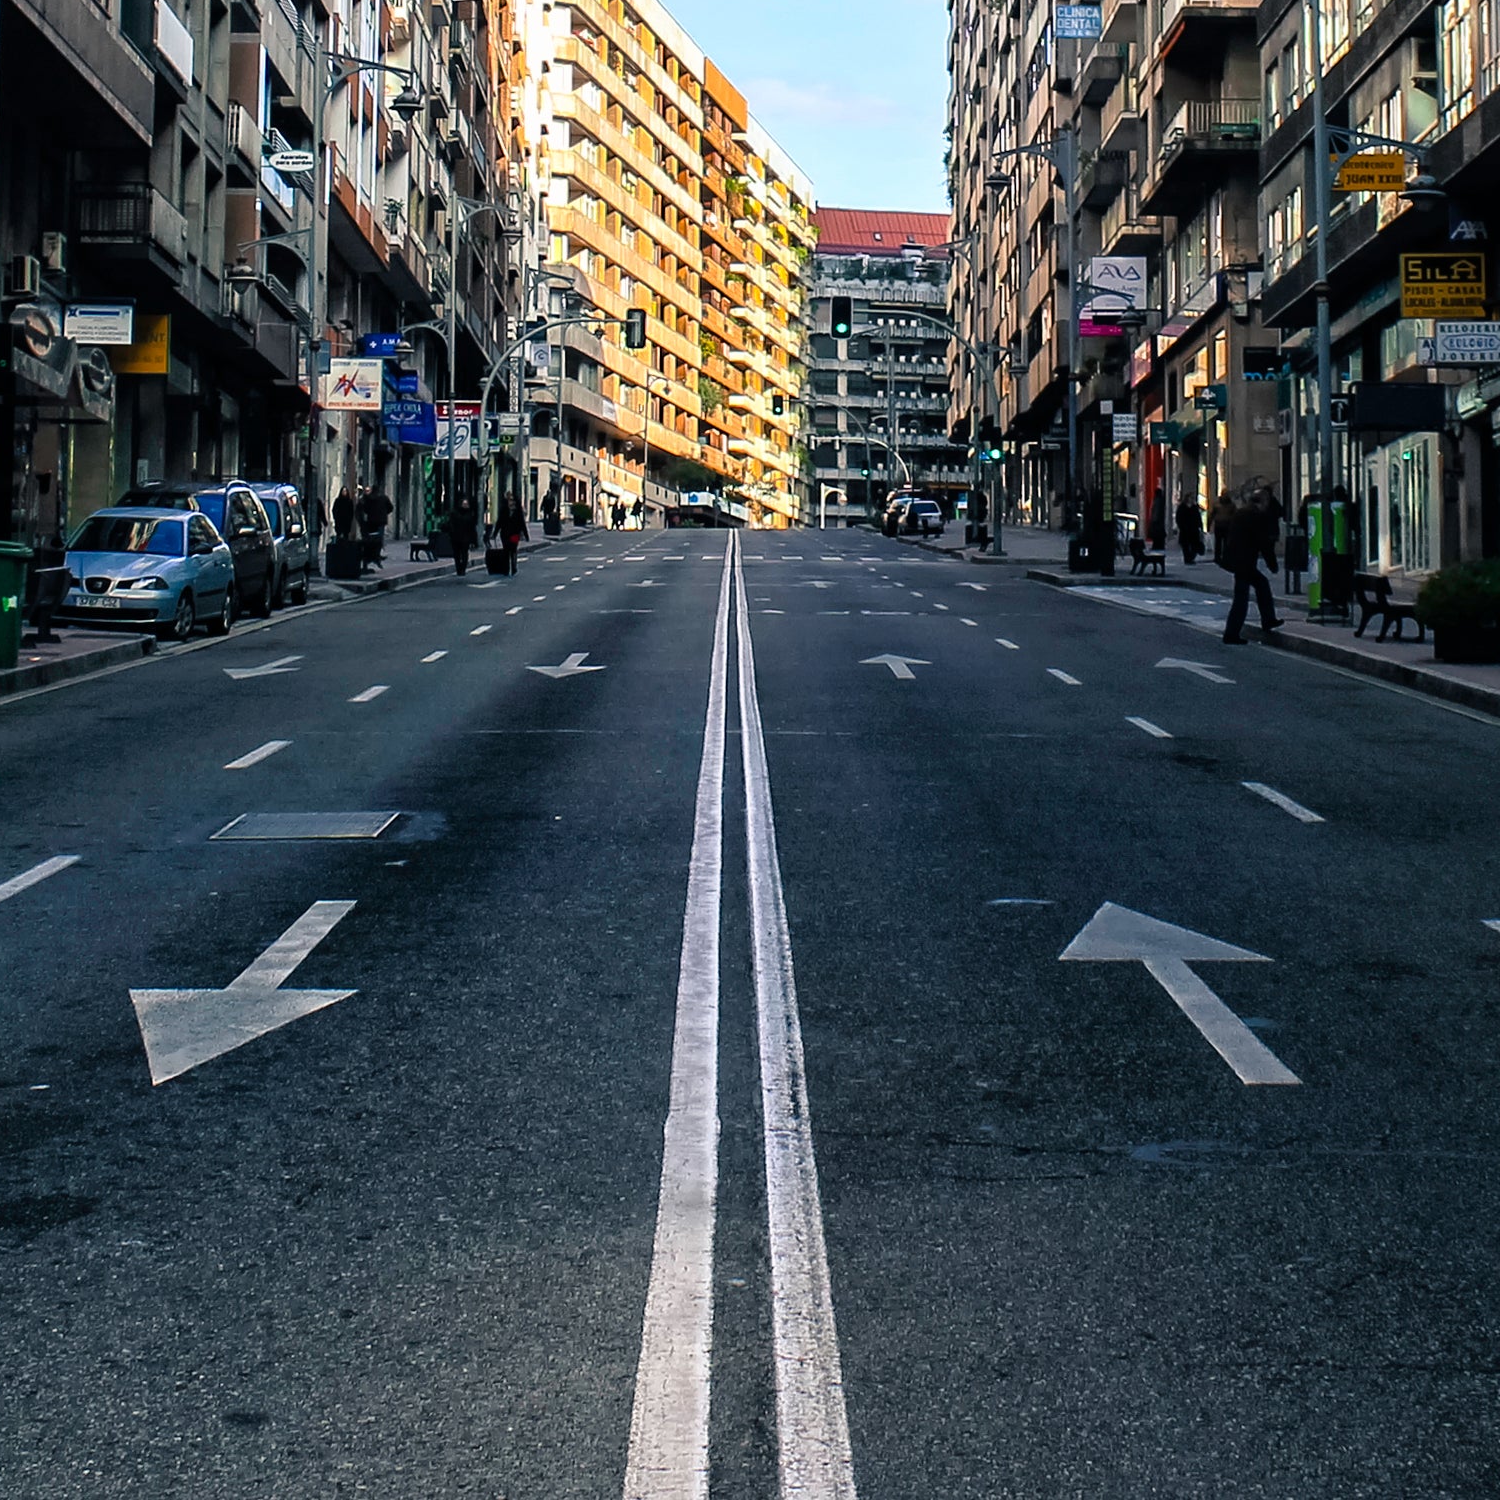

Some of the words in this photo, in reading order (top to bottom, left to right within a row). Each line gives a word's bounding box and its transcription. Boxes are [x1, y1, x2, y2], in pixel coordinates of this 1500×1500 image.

[1057, 8, 1099, 18] CLINICA
[1057, 18, 1099, 29] DENTAL
[1346, 174, 1374, 185] JUAN
[1450, 220, 1488, 240] AXA
[1405, 286, 1434, 295] PISOS
[1447, 286, 1482, 295] CASAS
[1449, 338, 1494, 348] EULOGIO
